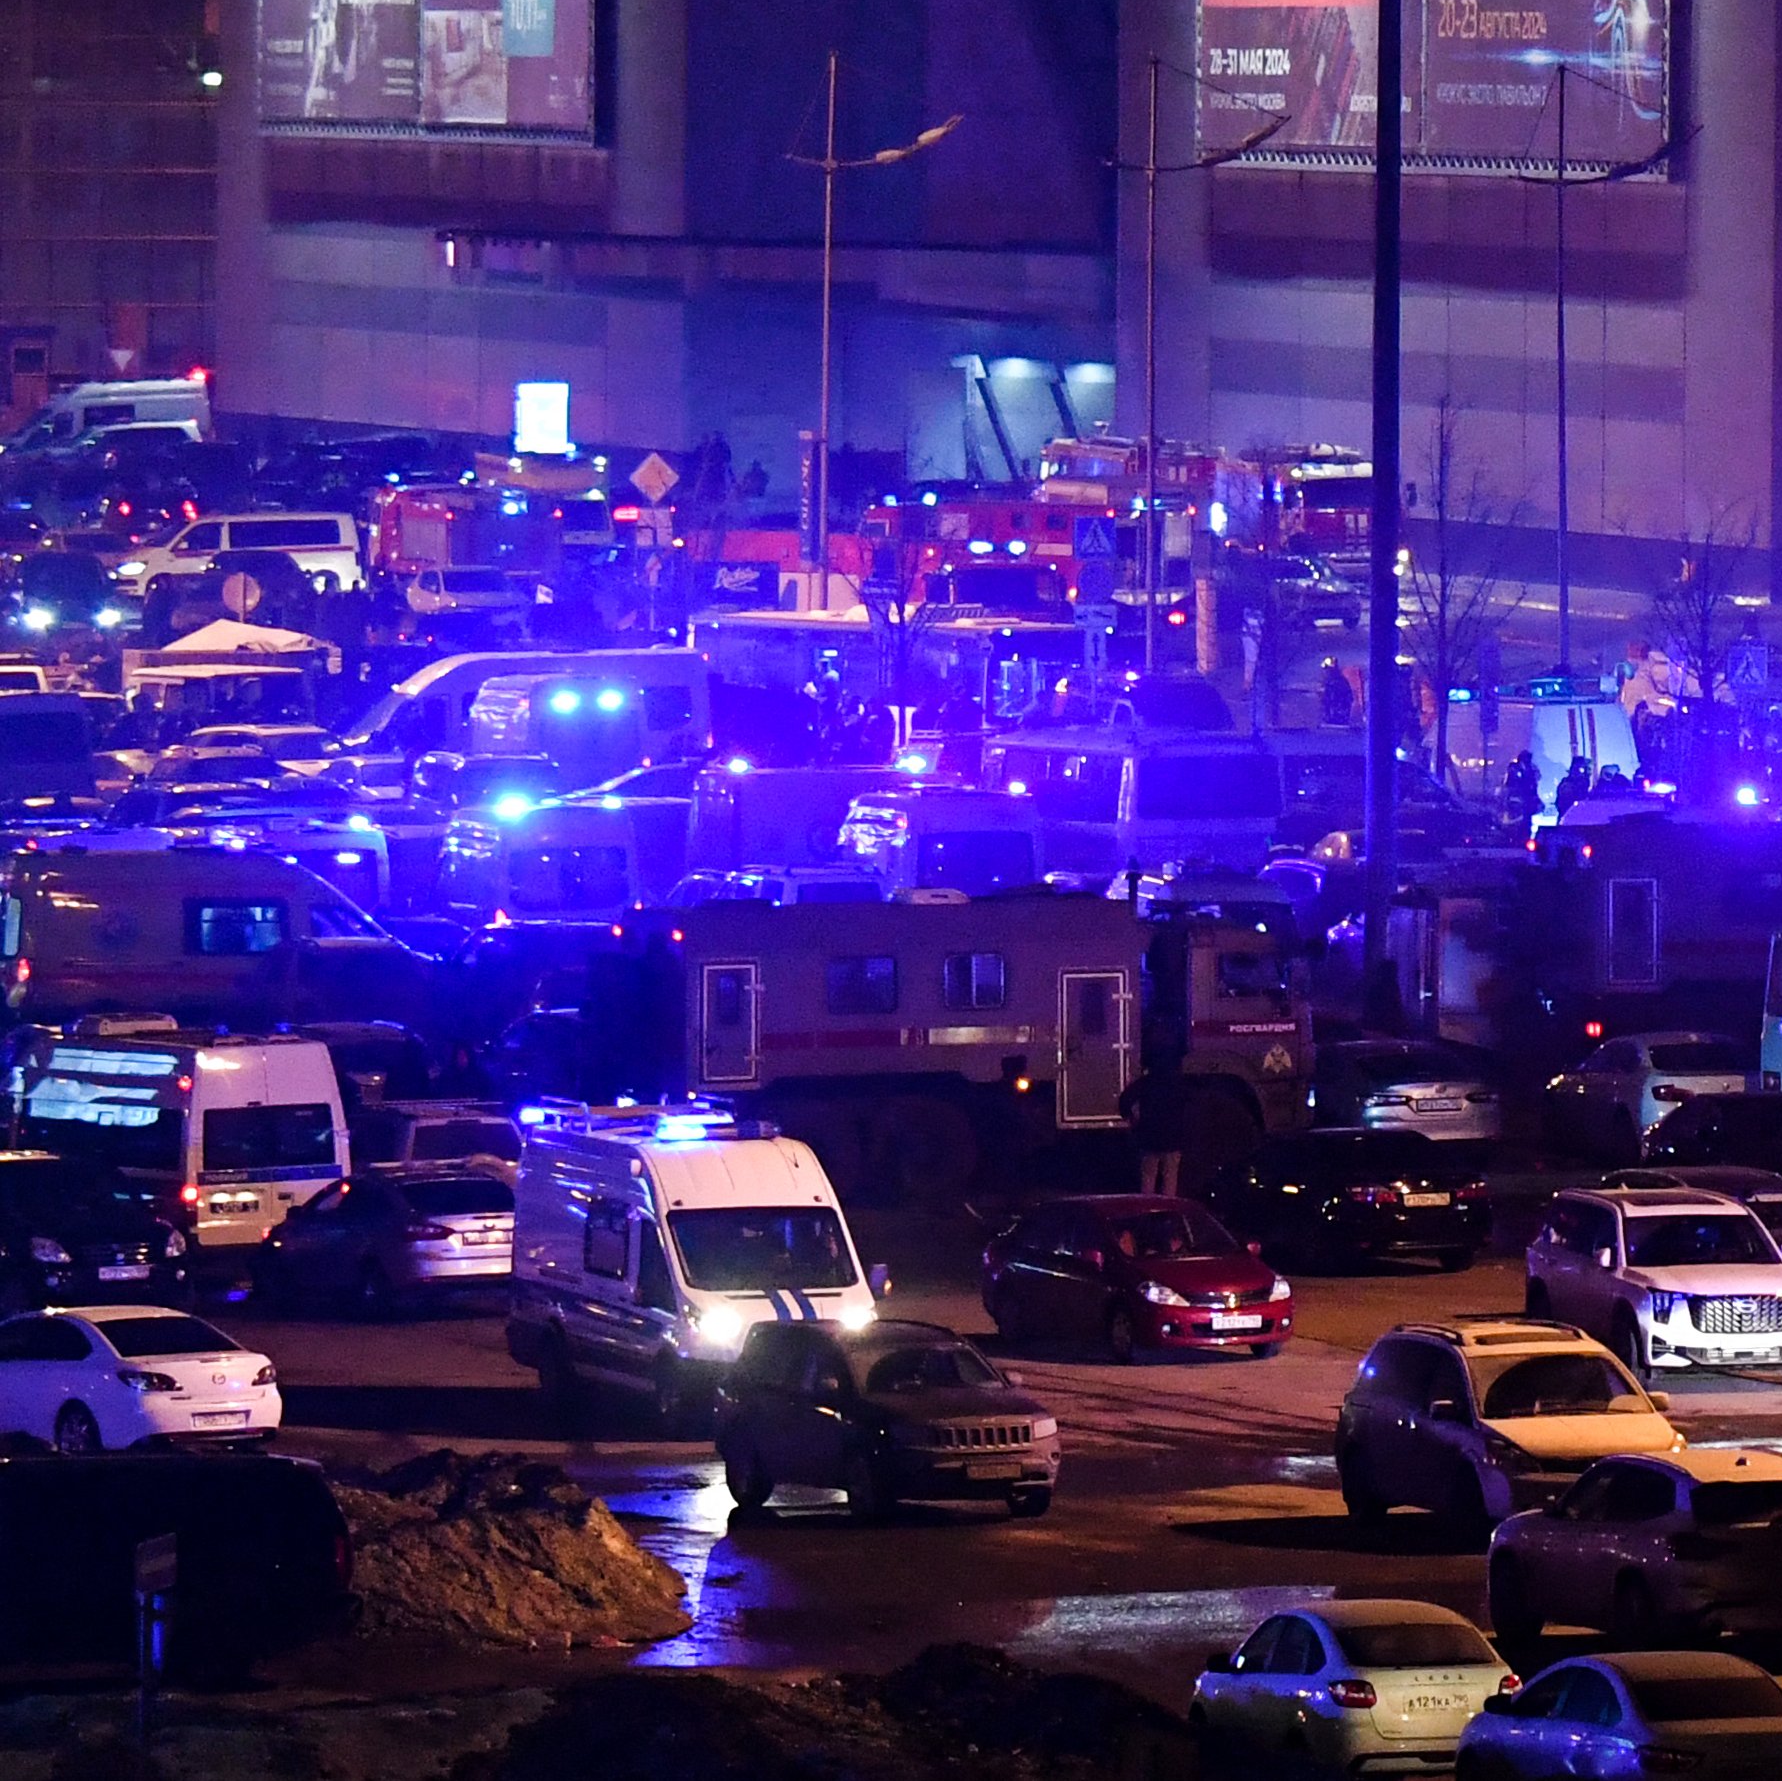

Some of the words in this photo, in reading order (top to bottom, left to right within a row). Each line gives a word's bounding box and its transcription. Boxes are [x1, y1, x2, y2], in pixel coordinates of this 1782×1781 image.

[1522, 11, 1547, 39] 2024
[1210, 48, 1238, 75] 28-31
[1239, 49, 1263, 75] МАЯ
[1264, 48, 1291, 75] 2024
[1229, 1022, 1296, 1033] РОСГВАРДИЯ
